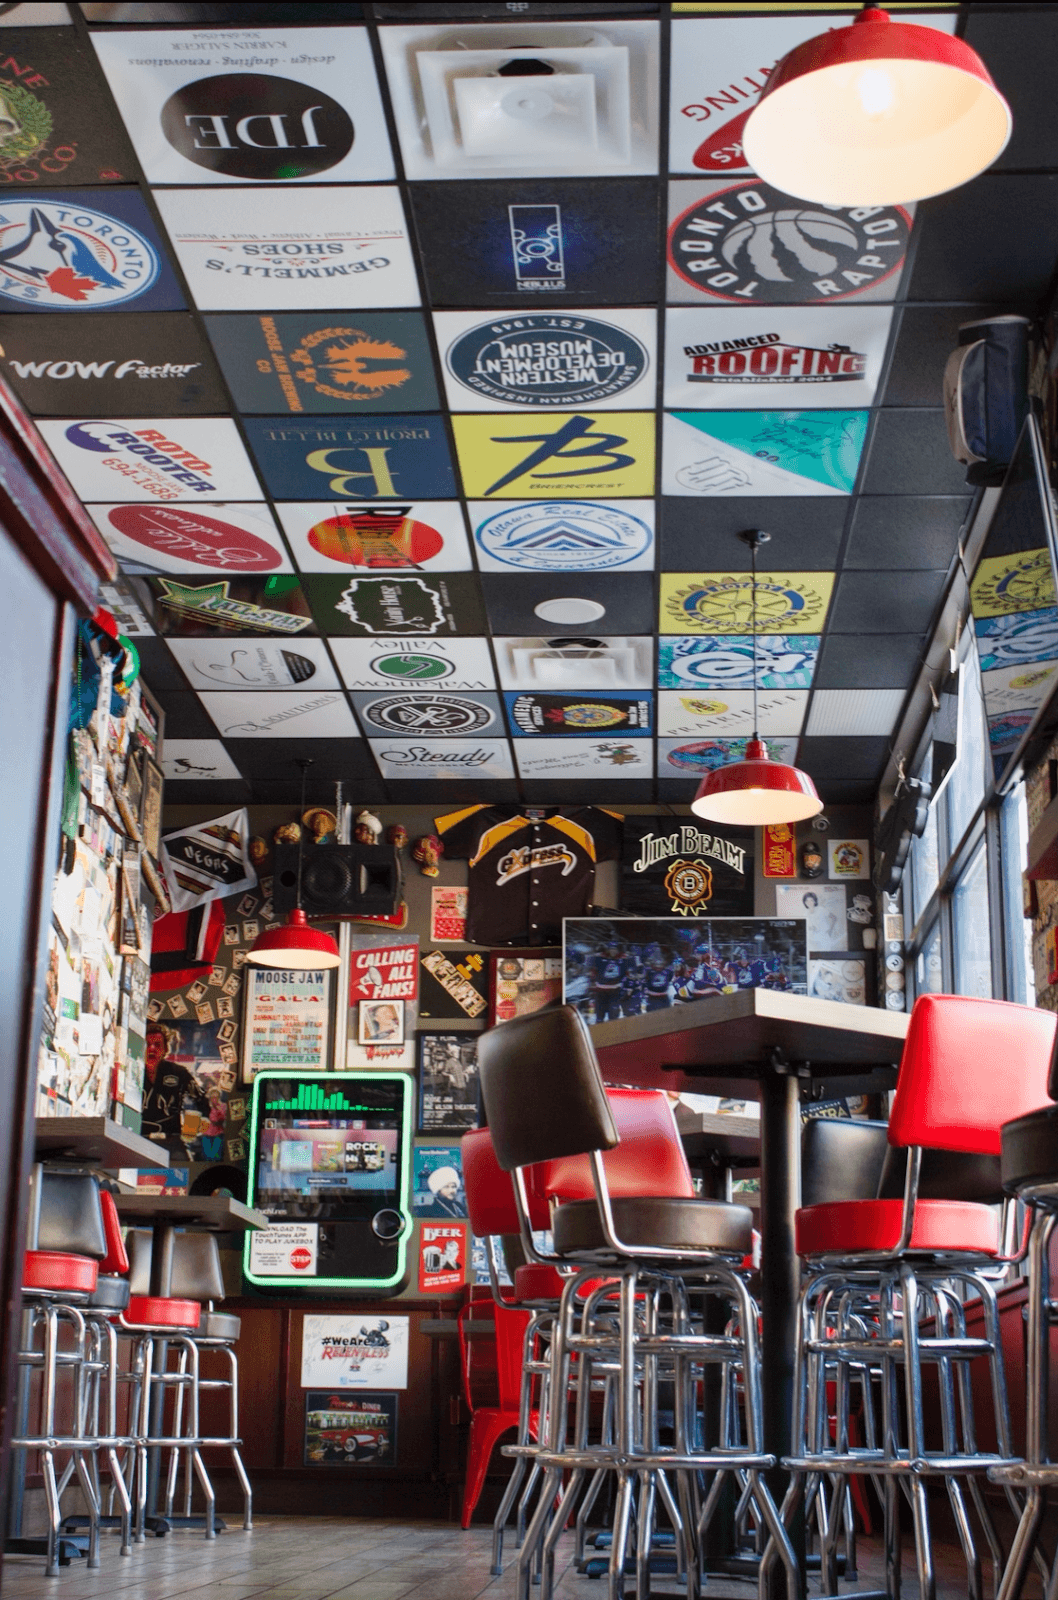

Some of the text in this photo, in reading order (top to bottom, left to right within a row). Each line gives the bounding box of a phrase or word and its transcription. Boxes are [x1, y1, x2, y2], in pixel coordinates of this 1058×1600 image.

[128, 55, 335, 68] design drafting renovations
[184, 106, 326, 149] JDE
[57, 210, 143, 279] TORONTO
[242, 243, 345, 256] SHOES
[680, 190, 901, 297] TORONTO RAPTOR
[205, 257, 391, 279] GEMMELL'S
[543, 318, 585, 330] EST.
[489, 339, 593, 359] MUSEUM
[683, 333, 781, 356] ADVANCED
[9, 359, 202, 379] WOW Factor
[472, 350, 626, 374] DEVELOPMENT
[692, 346, 867, 375] ROOFING
[467, 364, 638, 404] SASKATCHEWAN INSPIRED
[500, 368, 608, 386] WESTERN
[345, 429, 430, 441] PROJECT
[107, 432, 217, 492] ROOTER
[132, 429, 213, 476] ROTO-
[101, 457, 179, 501] 694-1688
[487, 513, 533, 537] Ottawa
[544, 506, 595, 516] Real
[370, 638, 446, 652] Valley
[353, 680, 487, 689] Wakamow
[261, 694, 338, 724] SOLUTIONS
[513, 697, 541, 733] PARAMEDIC
[380, 747, 496, 767] Steady
[186, 842, 232, 875] VEGAS
[633, 833, 680, 873] JIM
[680, 826, 747, 874] BEAM
[684, 877, 696, 890] B
[356, 948, 415, 969] CALLING
[255, 971, 325, 984] MOOSE JAW
[387, 965, 414, 981] ALL
[373, 981, 414, 999] FANS!
[345, 1141, 378, 1151] ROCK
[424, 1227, 463, 1241] BEER
[321, 1337, 370, 1346] #WeAre
